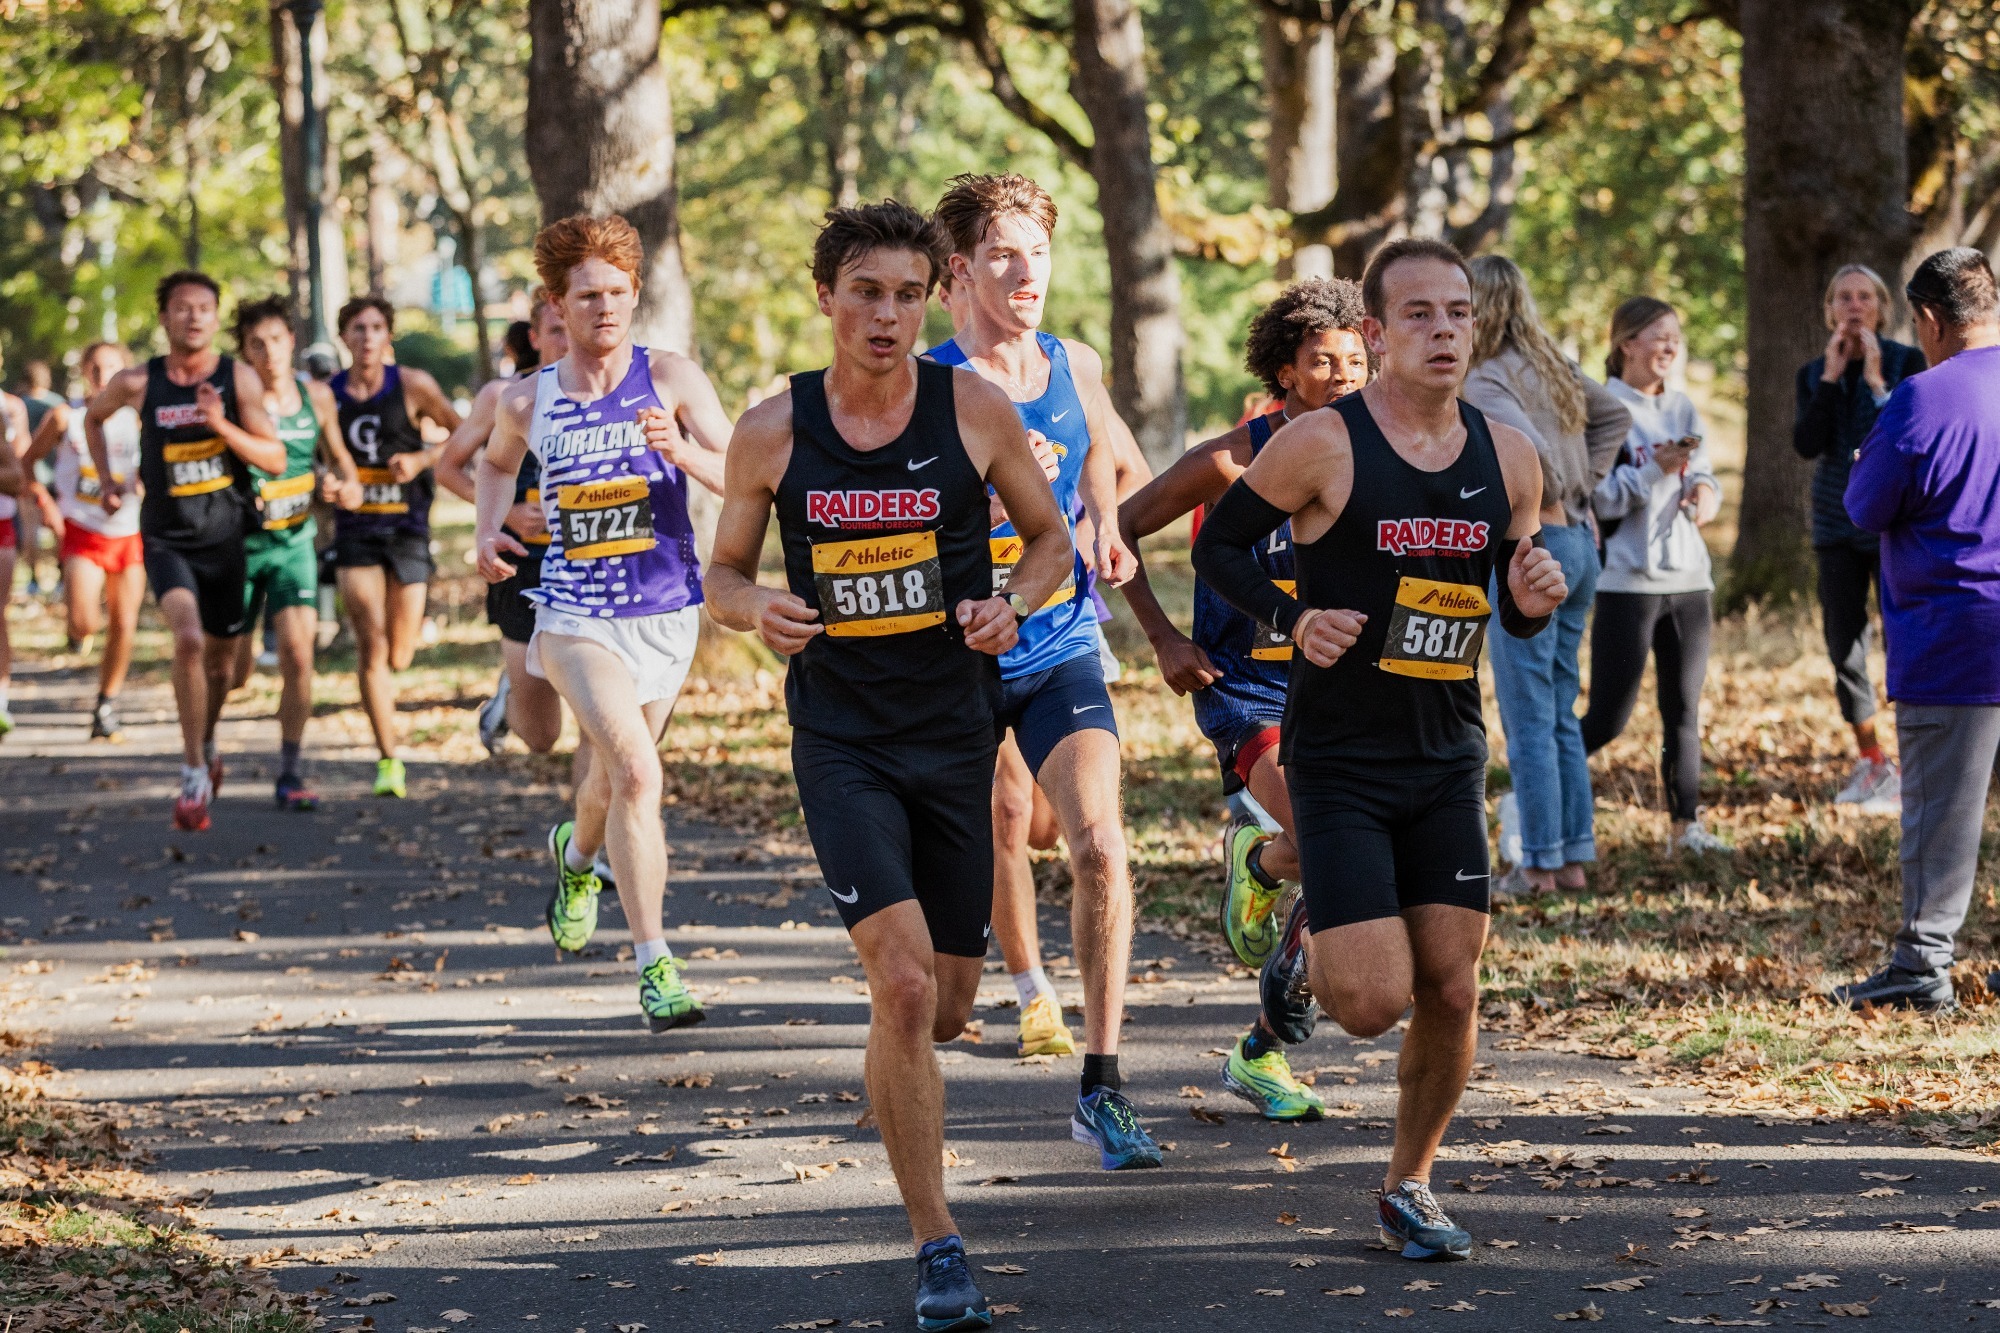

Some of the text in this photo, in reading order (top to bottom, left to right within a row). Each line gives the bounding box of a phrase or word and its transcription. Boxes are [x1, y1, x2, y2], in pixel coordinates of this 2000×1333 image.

[541, 420, 648, 462] PORTLAN
[573, 488, 631, 504] Athletic
[807, 488, 941, 528] RAIDERS
[569, 505, 639, 543] 5727
[840, 520, 923, 530] SOUTHERN OREGON
[1377, 518, 1490, 557] RAIDERS
[835, 545, 914, 568] Athletic
[1437, 549, 1471, 559] OREGON
[832, 569, 927, 615] 5818
[1418, 588, 1480, 610] Athletic
[1402, 615, 1479, 659] 5817
